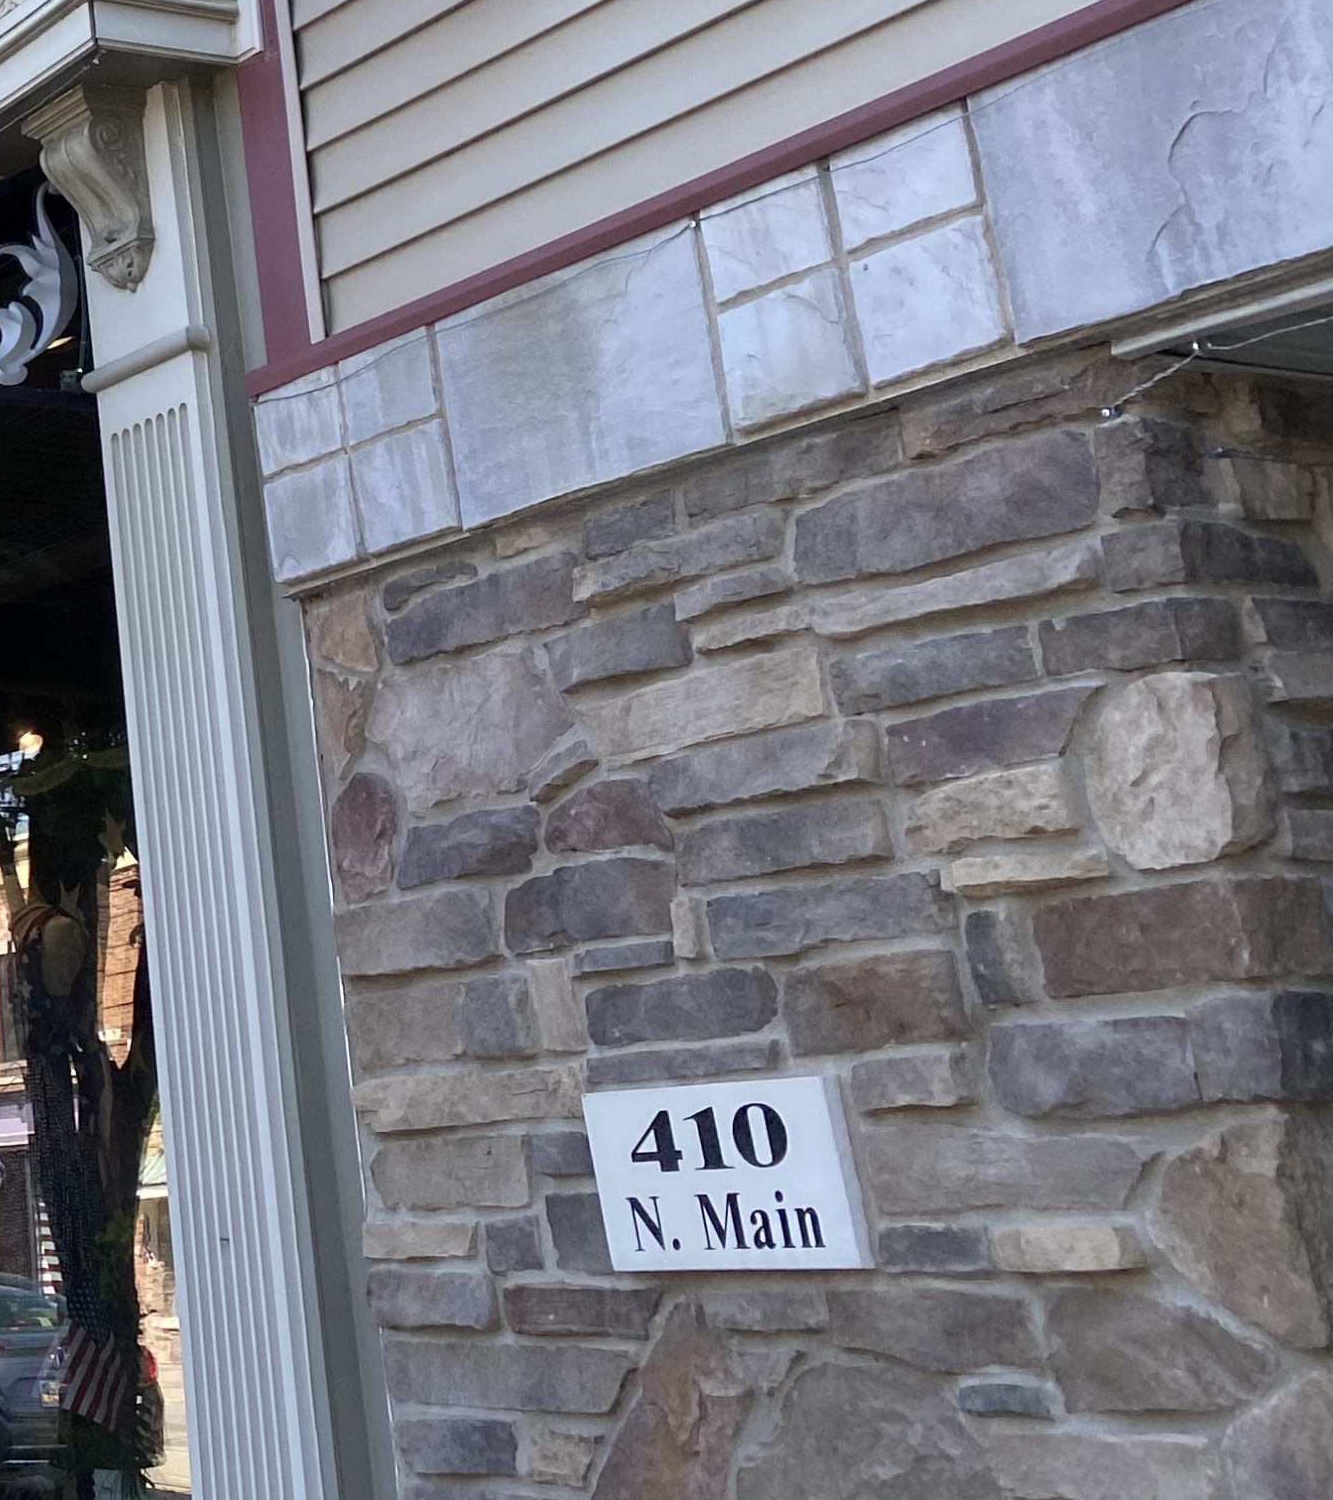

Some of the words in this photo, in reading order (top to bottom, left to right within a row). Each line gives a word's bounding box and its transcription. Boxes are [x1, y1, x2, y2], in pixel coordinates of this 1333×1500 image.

[631, 1102, 788, 1173] 410
[626, 1196, 681, 1251] N.
[694, 1190, 826, 1250] Main
